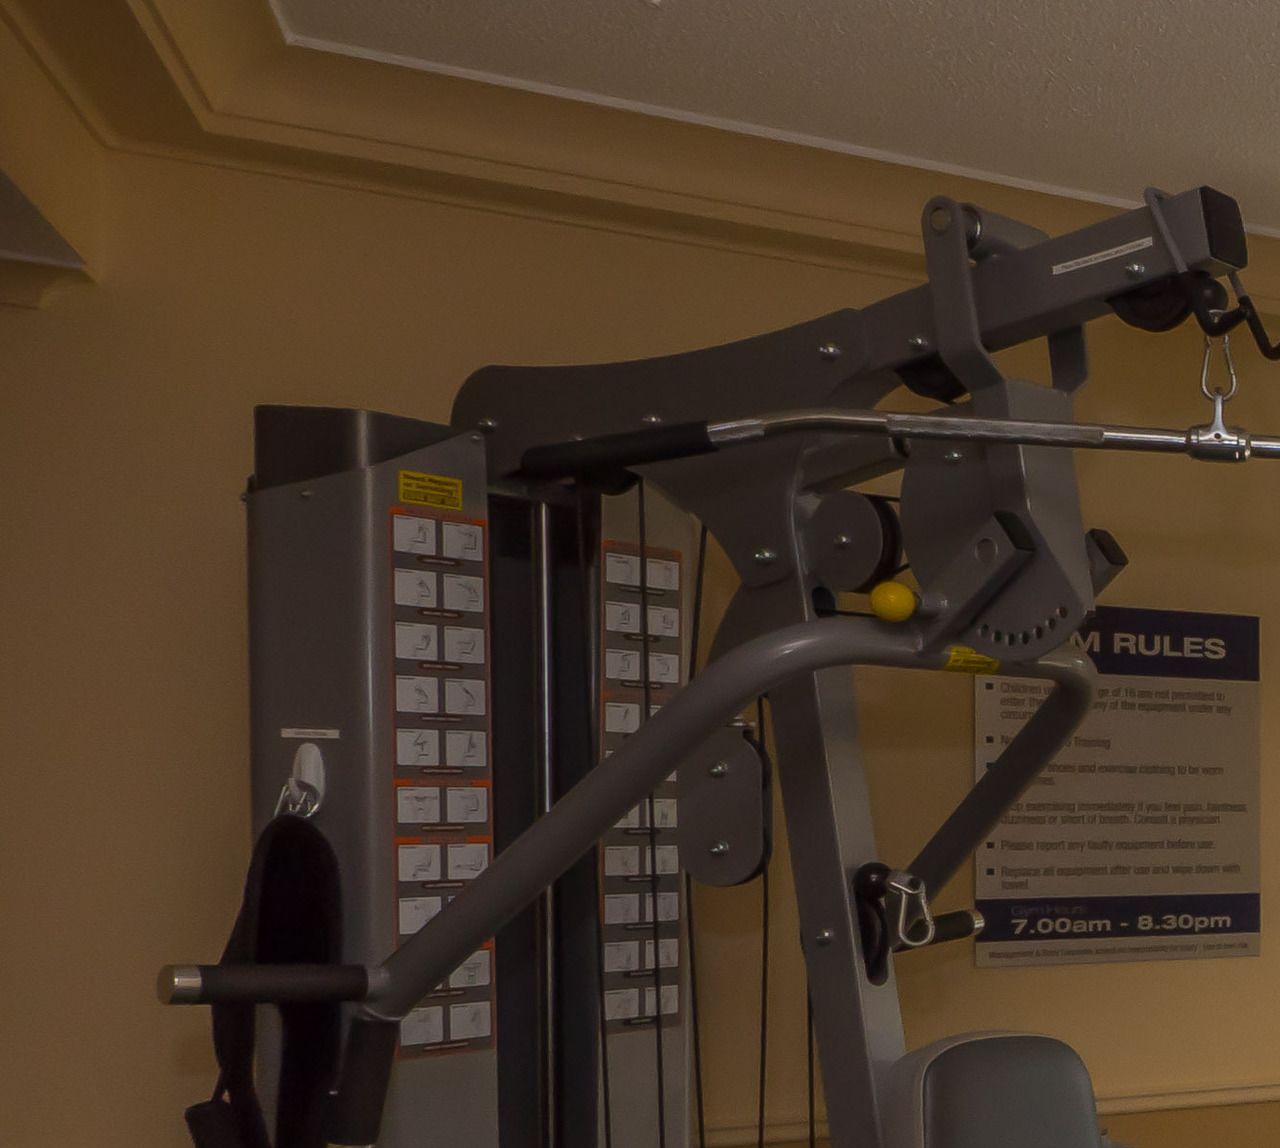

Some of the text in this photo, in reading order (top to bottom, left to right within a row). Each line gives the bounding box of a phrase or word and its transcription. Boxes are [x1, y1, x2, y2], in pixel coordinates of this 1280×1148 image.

[1113, 632, 1227, 660] RULES
[1011, 917, 1112, 935] 7.00am
[1137, 913, 1232, 932] 8.30pm
